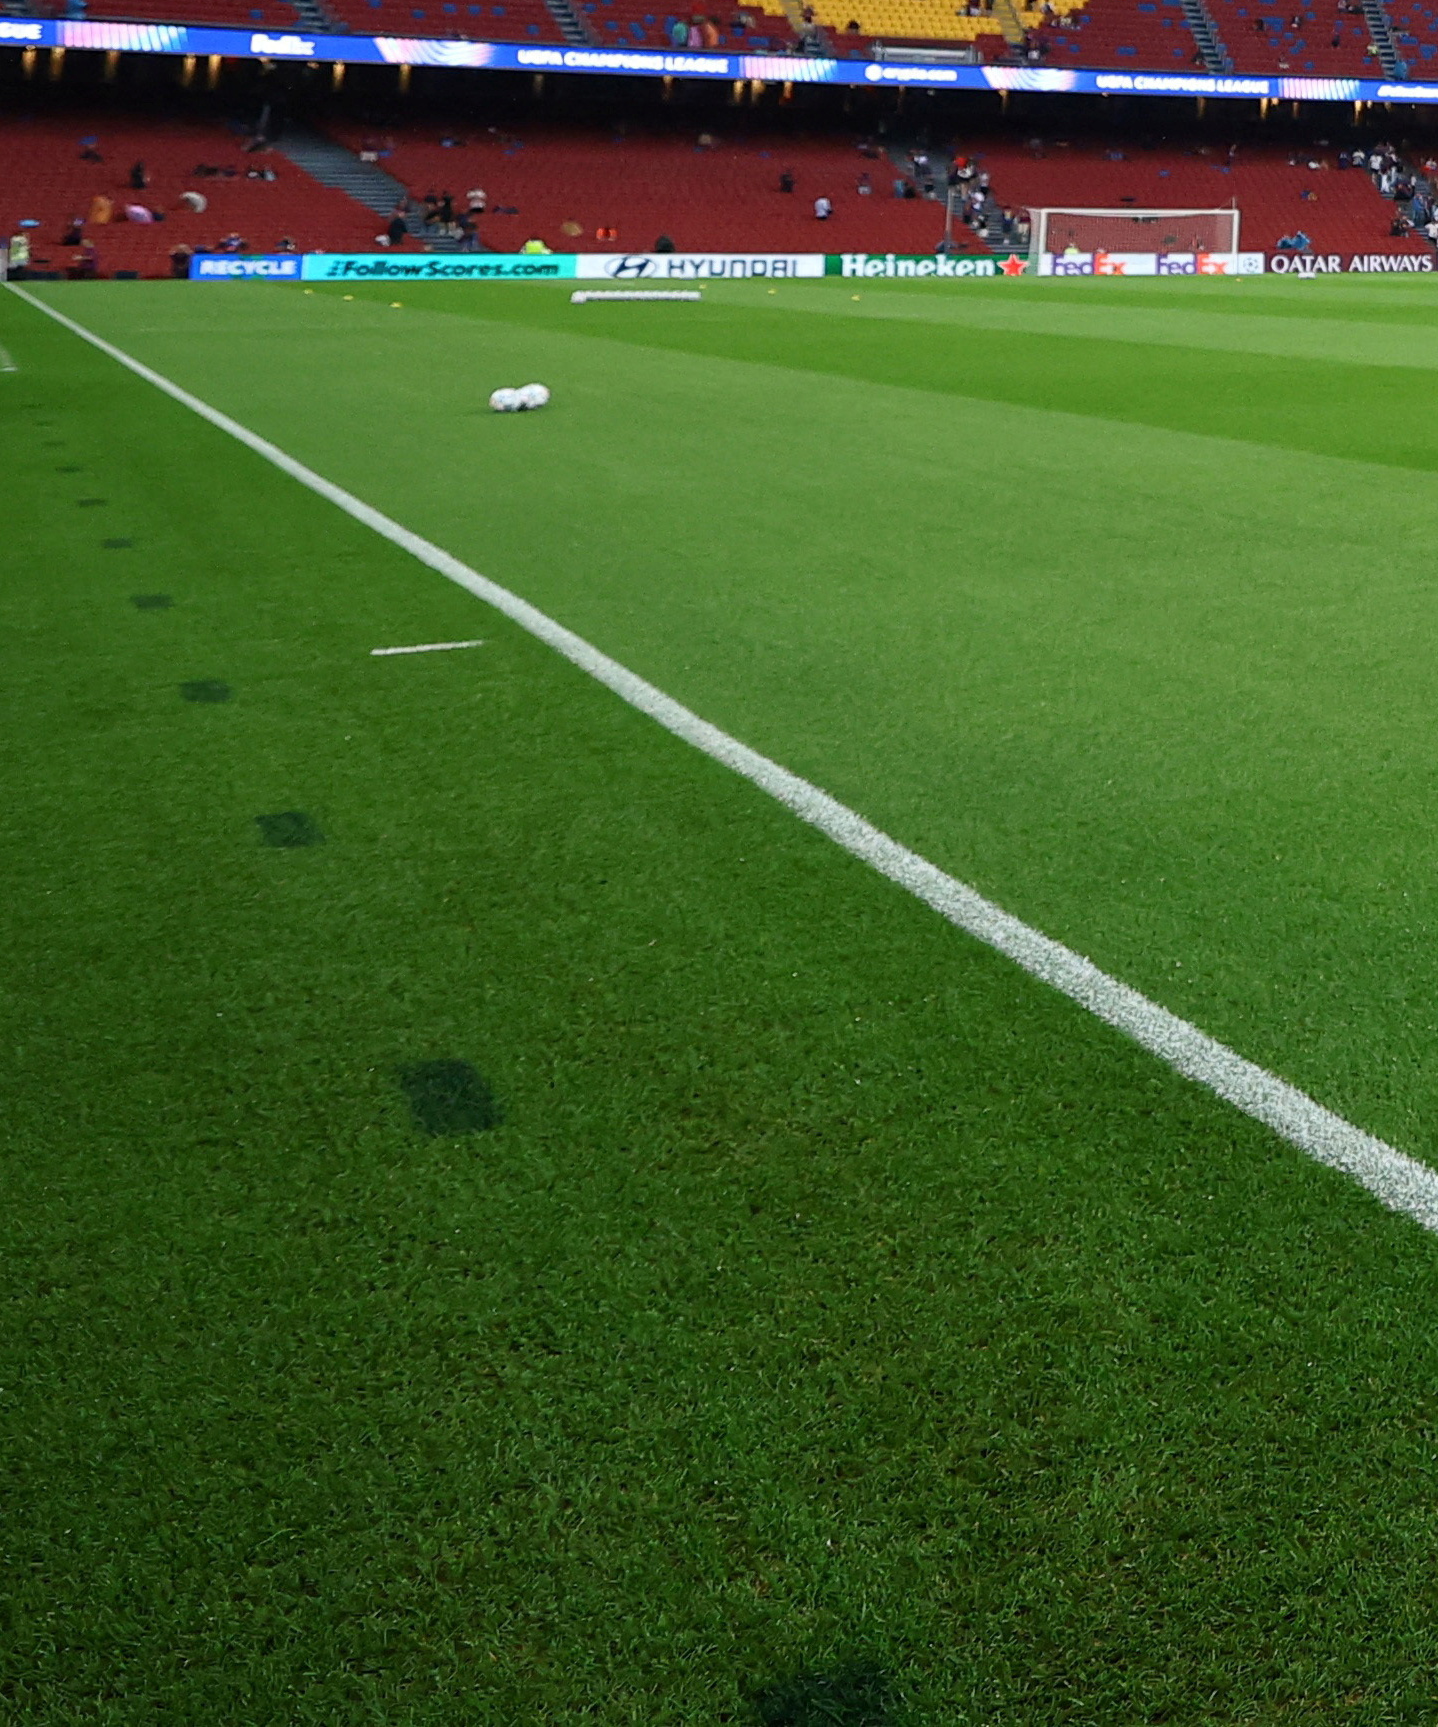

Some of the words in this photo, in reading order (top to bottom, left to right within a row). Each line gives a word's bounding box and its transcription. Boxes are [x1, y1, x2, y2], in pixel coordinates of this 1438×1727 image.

[667, 259, 797, 275] HYUNDAI
[840, 254, 996, 277] Heineken
[1053, 253, 1126, 274] FedEx
[1156, 253, 1227, 274] FedEx
[1271, 255, 1341, 273] QATAR
[1349, 255, 1432, 272] AIRWAYS
